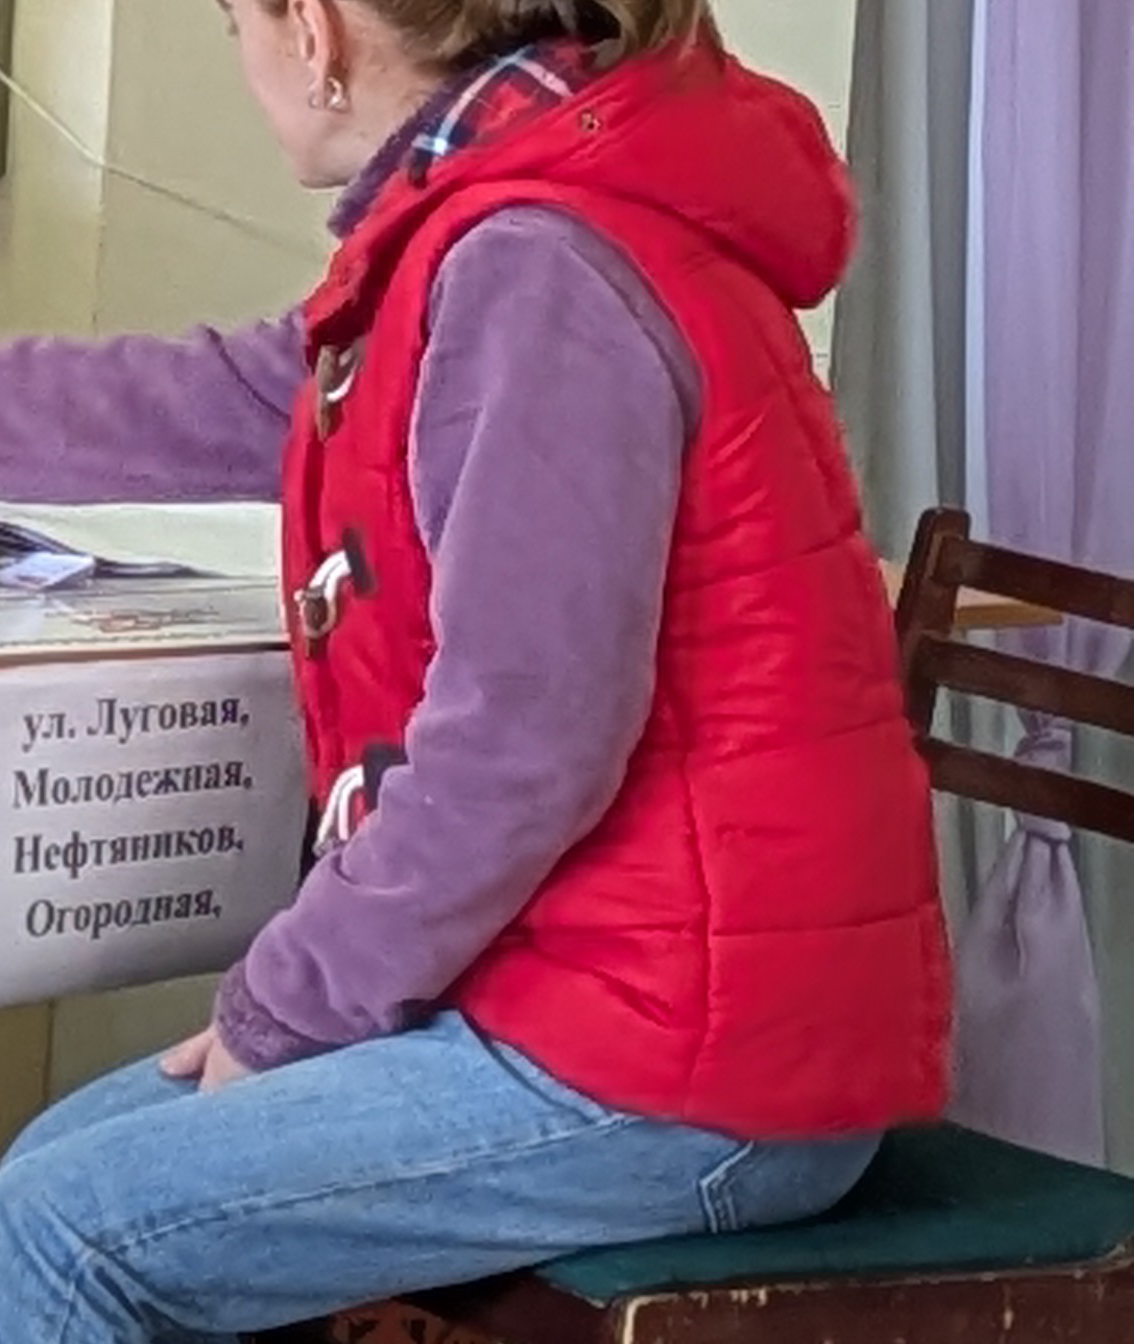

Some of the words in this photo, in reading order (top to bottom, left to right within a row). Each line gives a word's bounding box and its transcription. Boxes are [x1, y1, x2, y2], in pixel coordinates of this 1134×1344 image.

[21, 711, 76, 754] ул.
[86, 697, 250, 744] Луговая,
[13, 761, 252, 809] Молодежная,
[14, 825, 244, 880] Нефтяников,
[25, 889, 221, 939] Огородная,
